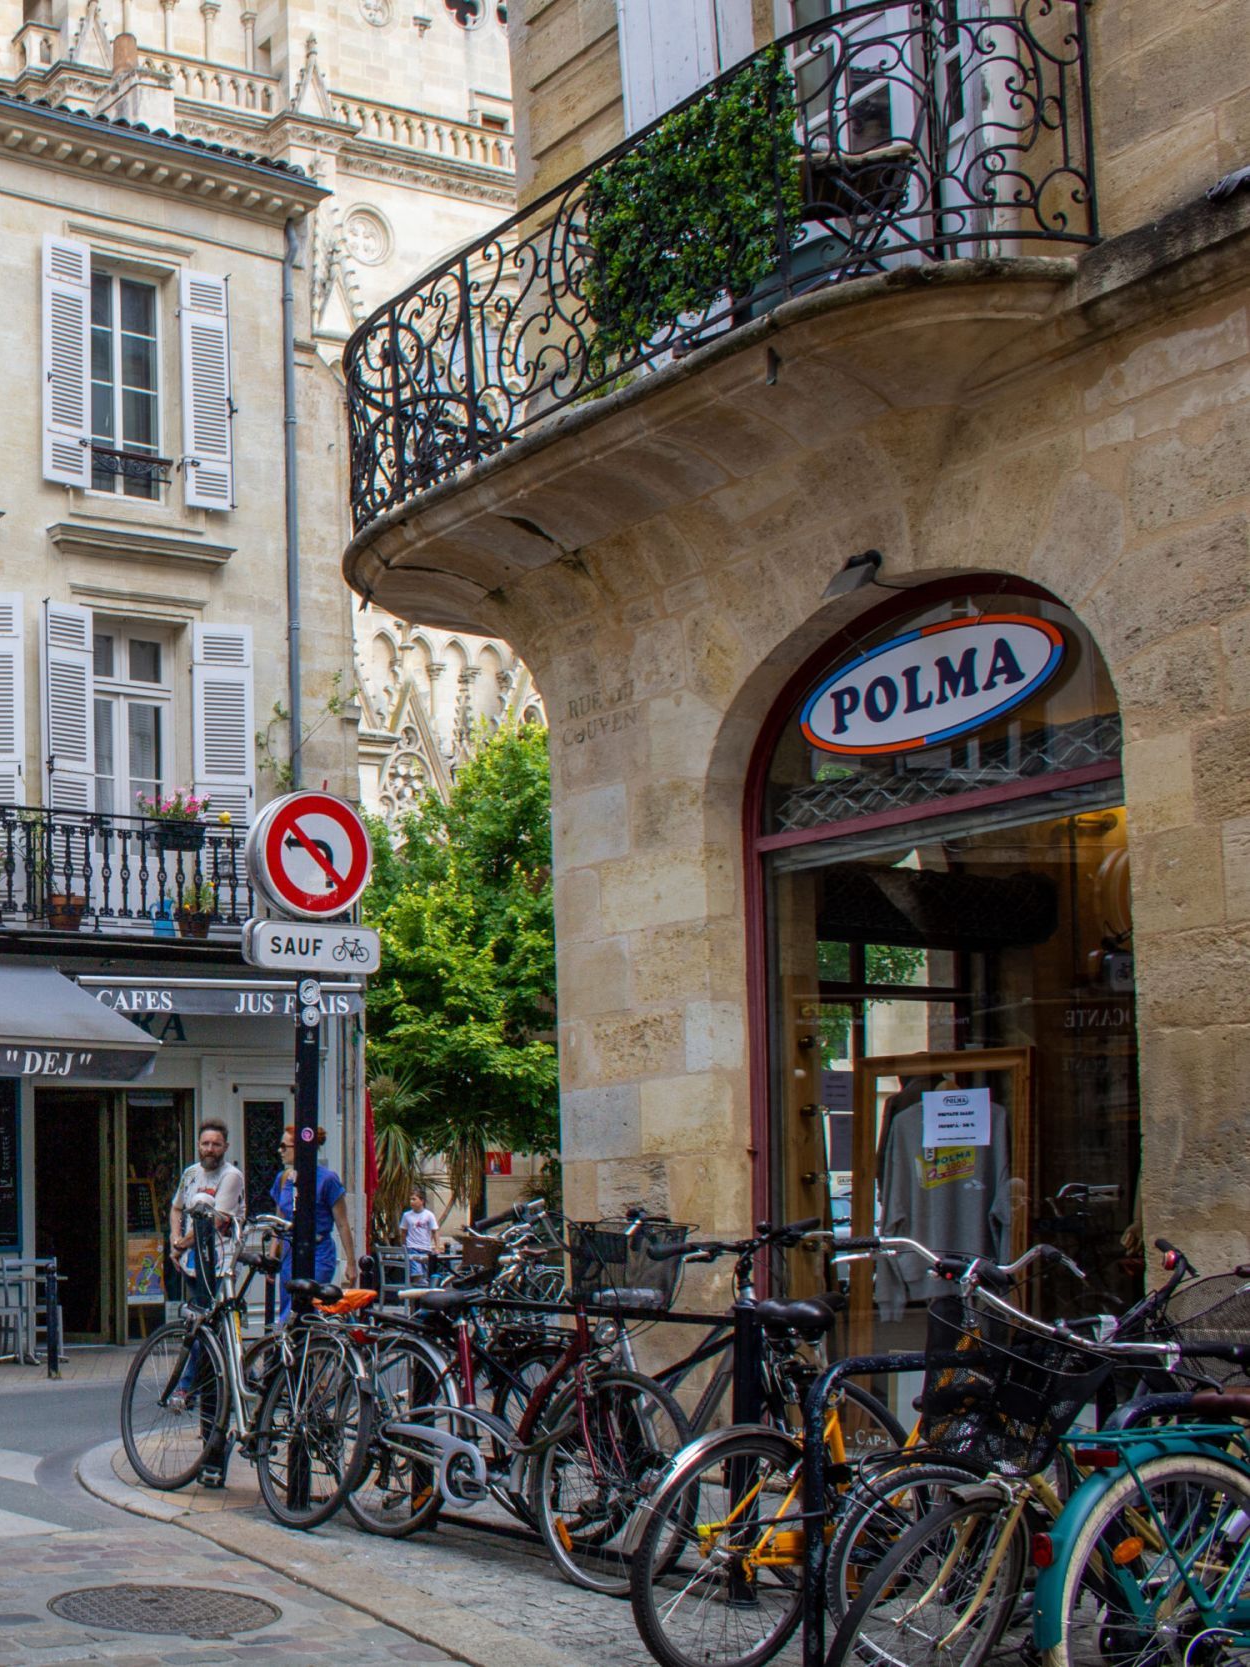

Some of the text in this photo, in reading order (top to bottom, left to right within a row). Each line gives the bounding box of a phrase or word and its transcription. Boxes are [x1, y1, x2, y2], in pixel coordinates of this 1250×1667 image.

[830, 637, 1026, 735] POLMA
[270, 936, 323, 956] SAUF
[96, 990, 173, 1011] CAFES
[235, 992, 350, 1014] JUS FAIS
